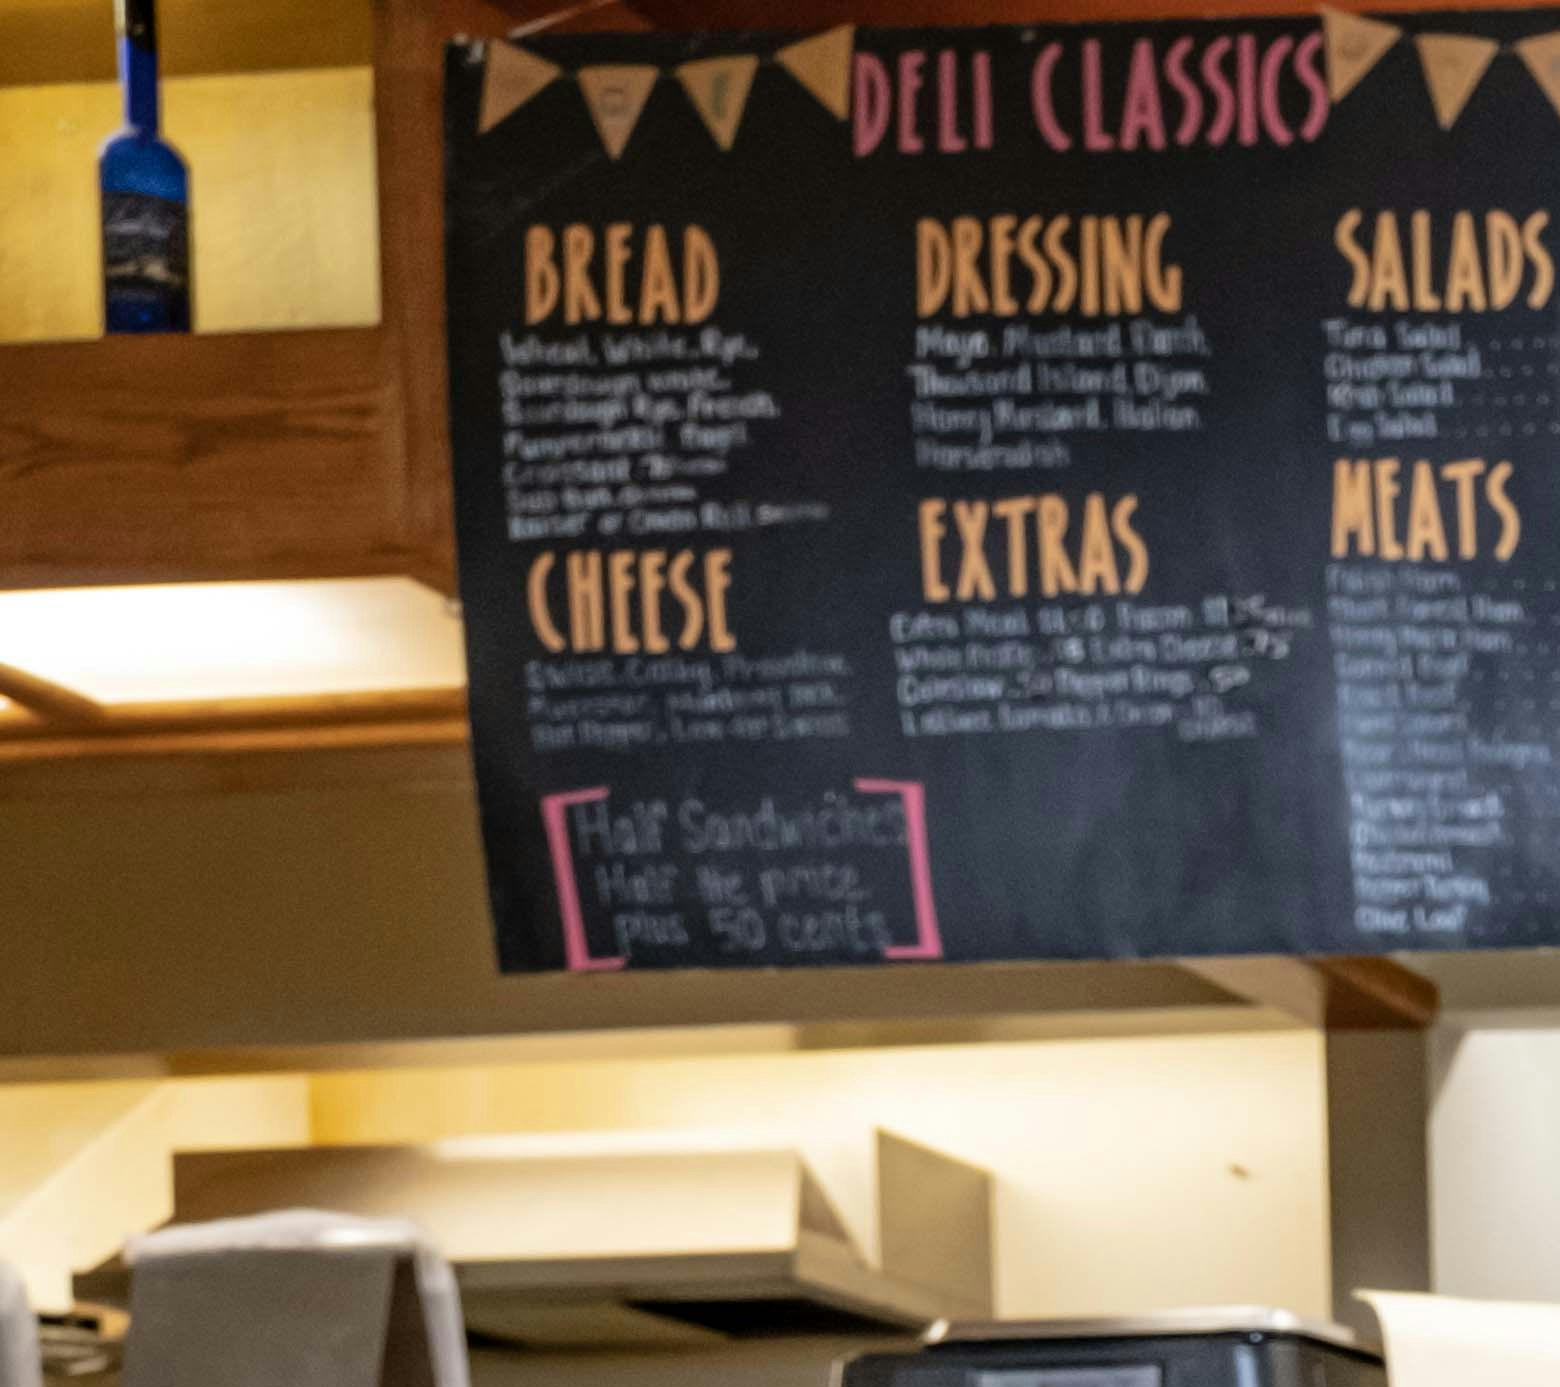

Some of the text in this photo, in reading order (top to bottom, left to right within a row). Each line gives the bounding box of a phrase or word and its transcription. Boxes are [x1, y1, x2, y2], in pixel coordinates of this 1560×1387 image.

[854, 32, 1330, 157] DELI CLASSICS
[523, 222, 720, 325] BREAD
[916, 213, 1183, 318] DRESSING
[1334, 208, 1556, 312] SALADS
[918, 494, 1149, 602] EXTRAS
[1329, 457, 1521, 561] MEATS
[527, 549, 736, 653] CHEESE
